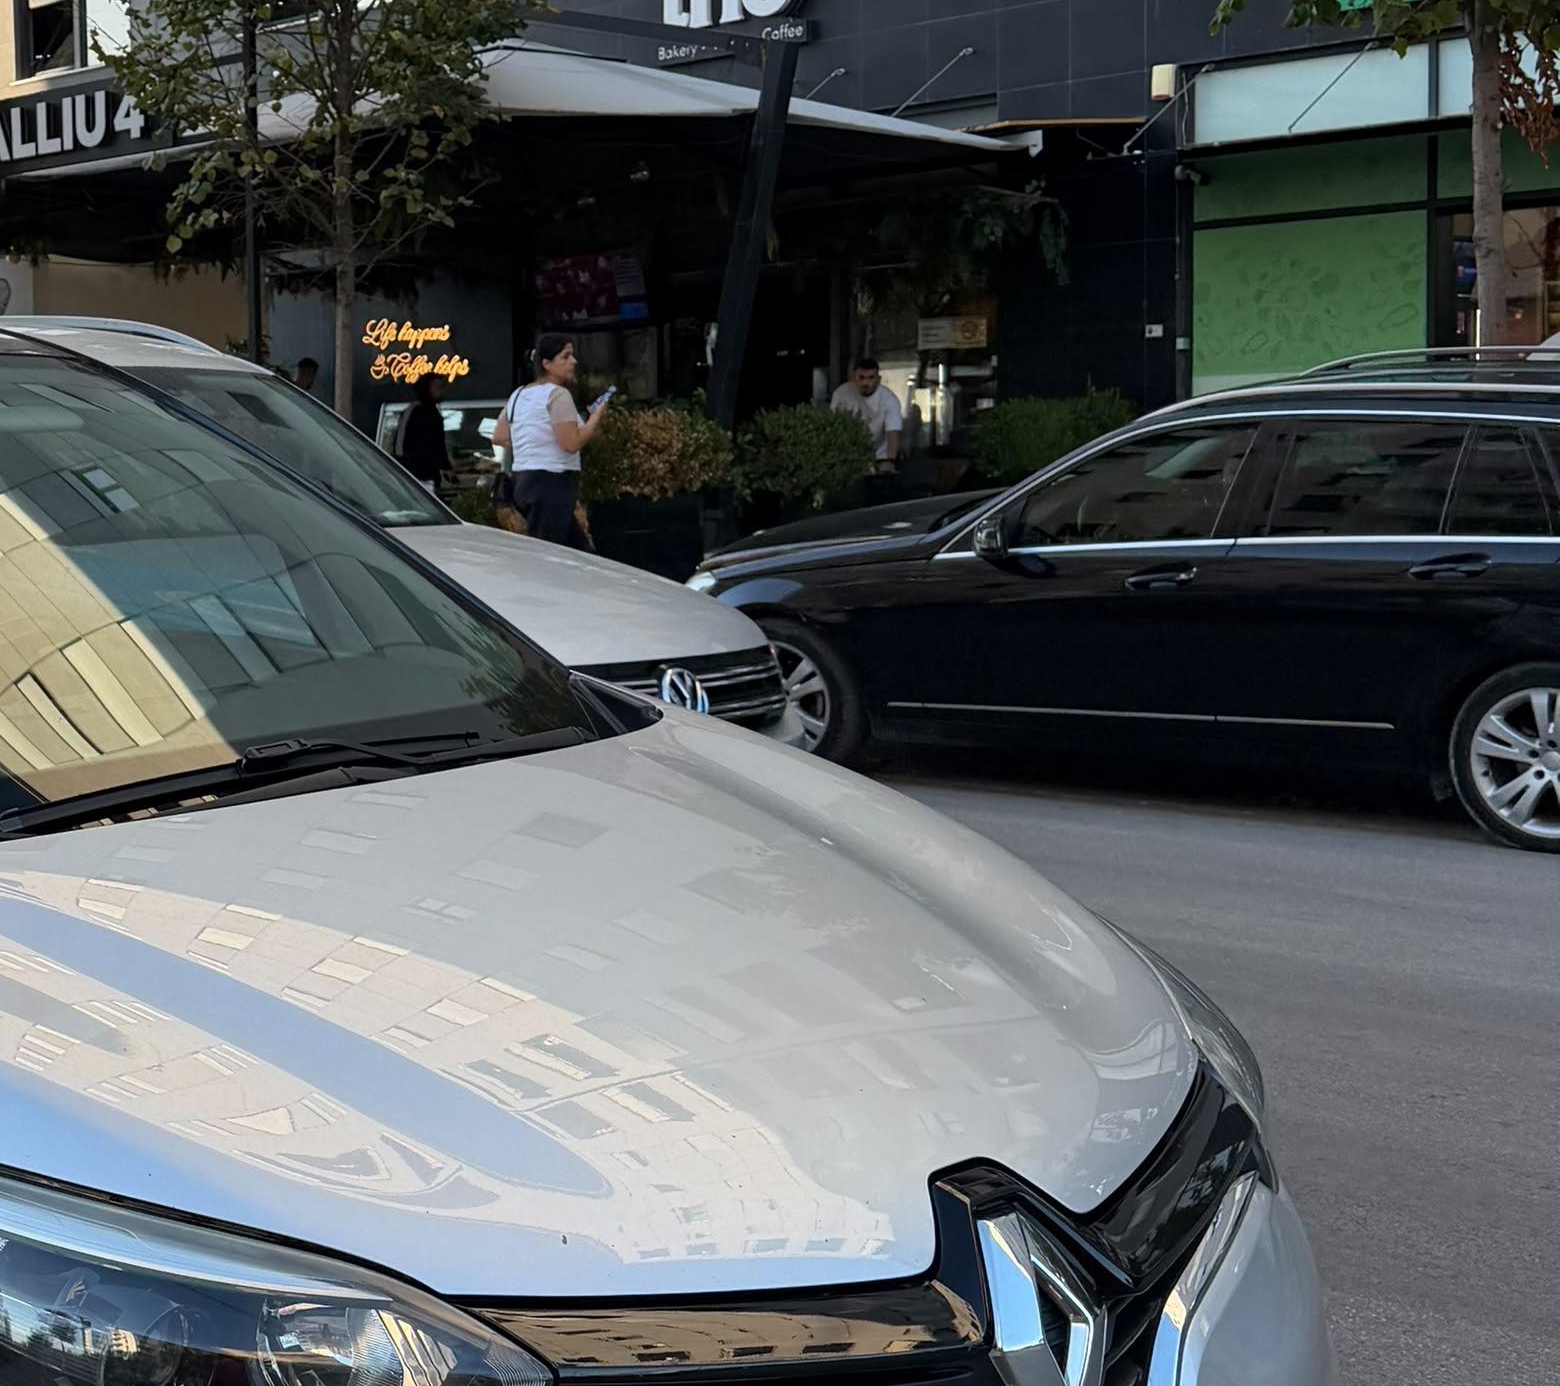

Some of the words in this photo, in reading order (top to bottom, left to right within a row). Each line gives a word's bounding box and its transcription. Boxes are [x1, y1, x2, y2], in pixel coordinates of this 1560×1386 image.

[761, 22, 804, 41] Coffee
[657, 43, 698, 61] Bakery
[113, 93, 145, 140] 4
[362, 318, 398, 350] Life
[397, 320, 450, 349] happens
[386, 352, 433, 384] Coffee
[433, 354, 470, 383] helps
